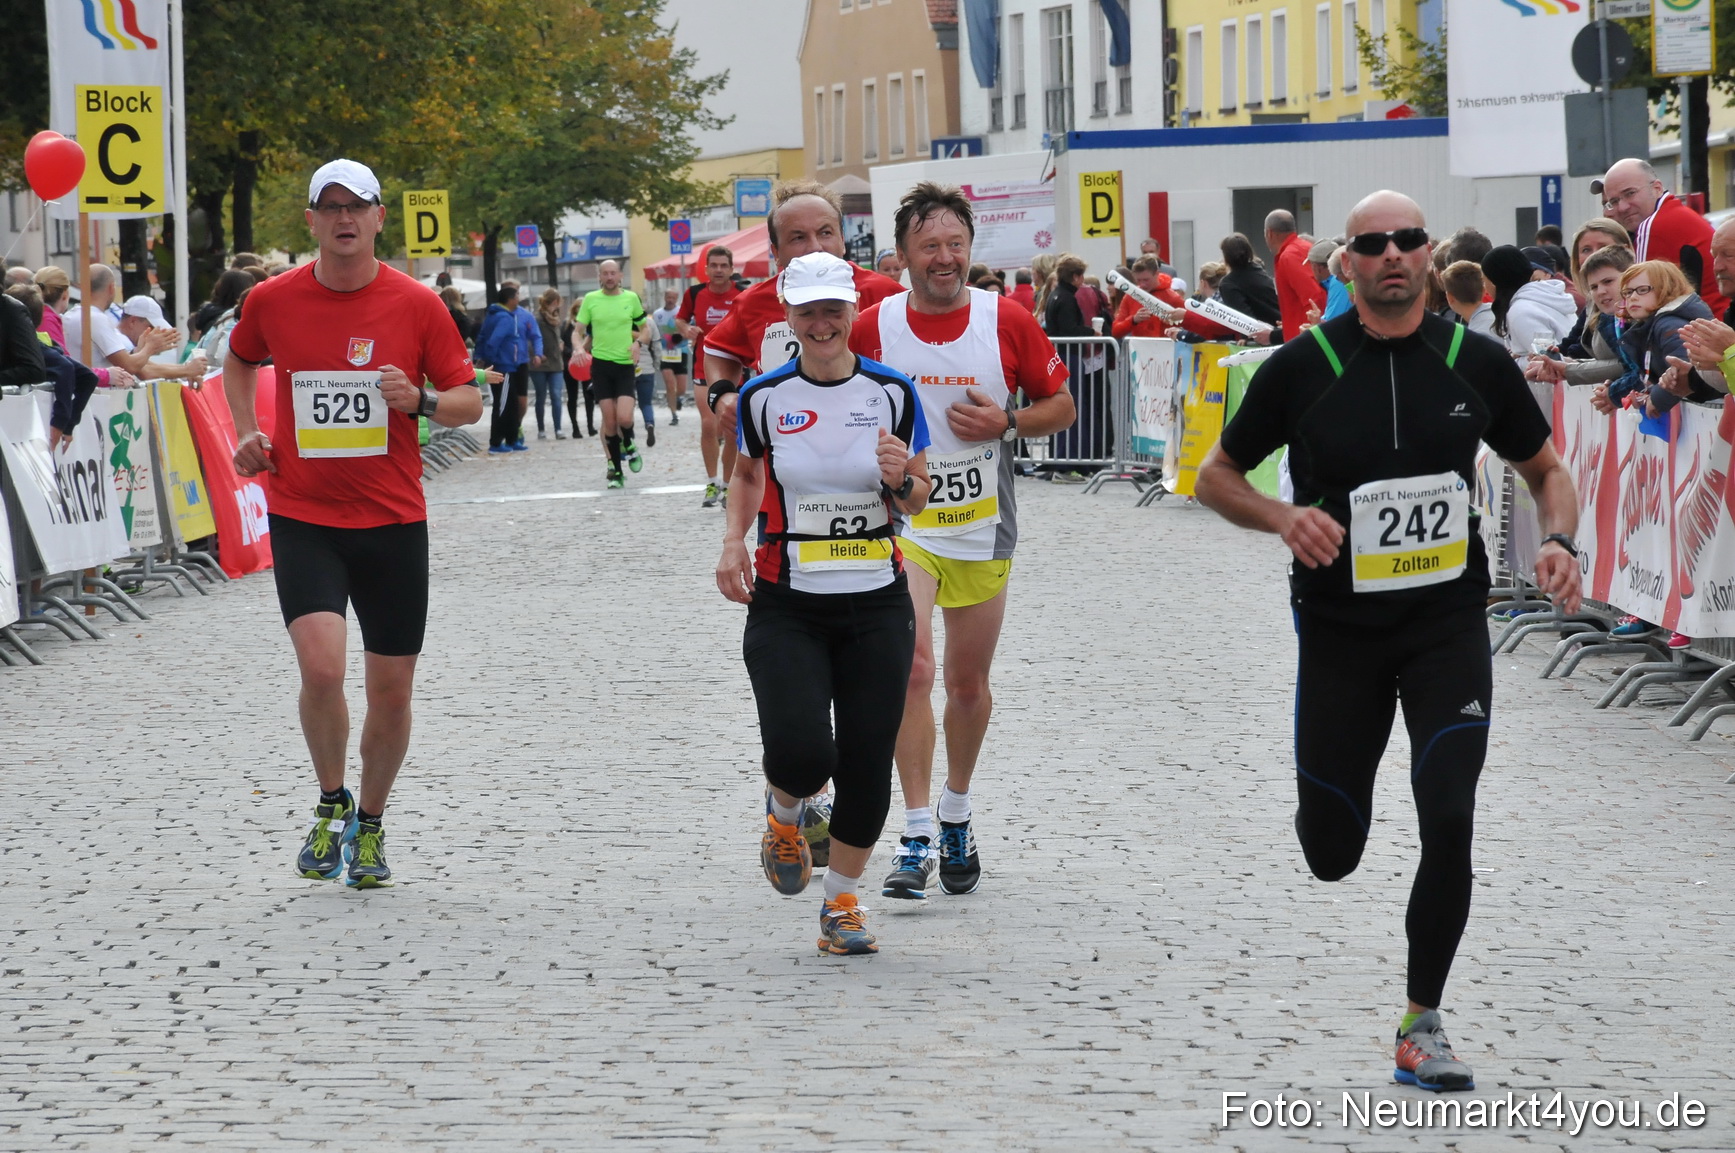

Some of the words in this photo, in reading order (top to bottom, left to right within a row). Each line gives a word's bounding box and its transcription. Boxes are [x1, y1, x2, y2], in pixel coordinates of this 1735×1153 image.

[1636, 2, 1650, 12] Gas
[86, 90, 152, 113] Block
[98, 123, 142, 185] C
[1084, 173, 1118, 187] Block
[408, 194, 443, 206] Block
[1091, 192, 1114, 223] D
[980, 211, 1028, 224] DAHMIT
[416, 211, 439, 243] D
[520, 247, 538, 255] TAXI
[672, 244, 691, 252] TAXI
[294, 380, 325, 388] PARTL
[327, 380, 372, 388] Neumarkt
[921, 375, 981, 386] KLEBL
[313, 392, 371, 424] 529
[778, 412, 806, 427] tkn
[940, 455, 982, 470] Neumarkt
[928, 467, 983, 504] 259
[1354, 491, 1394, 505] PARTL
[1397, 485, 1452, 501] Neumarkt
[798, 503, 832, 512] PARTL
[835, 500, 880, 512] Neumarkt
[938, 509, 976, 524] Rainer
[1378, 500, 1450, 547] 242
[830, 544, 867, 557] Heide
[1392, 555, 1439, 574] Zoltan
[1460, 708, 1486, 718] adidas
